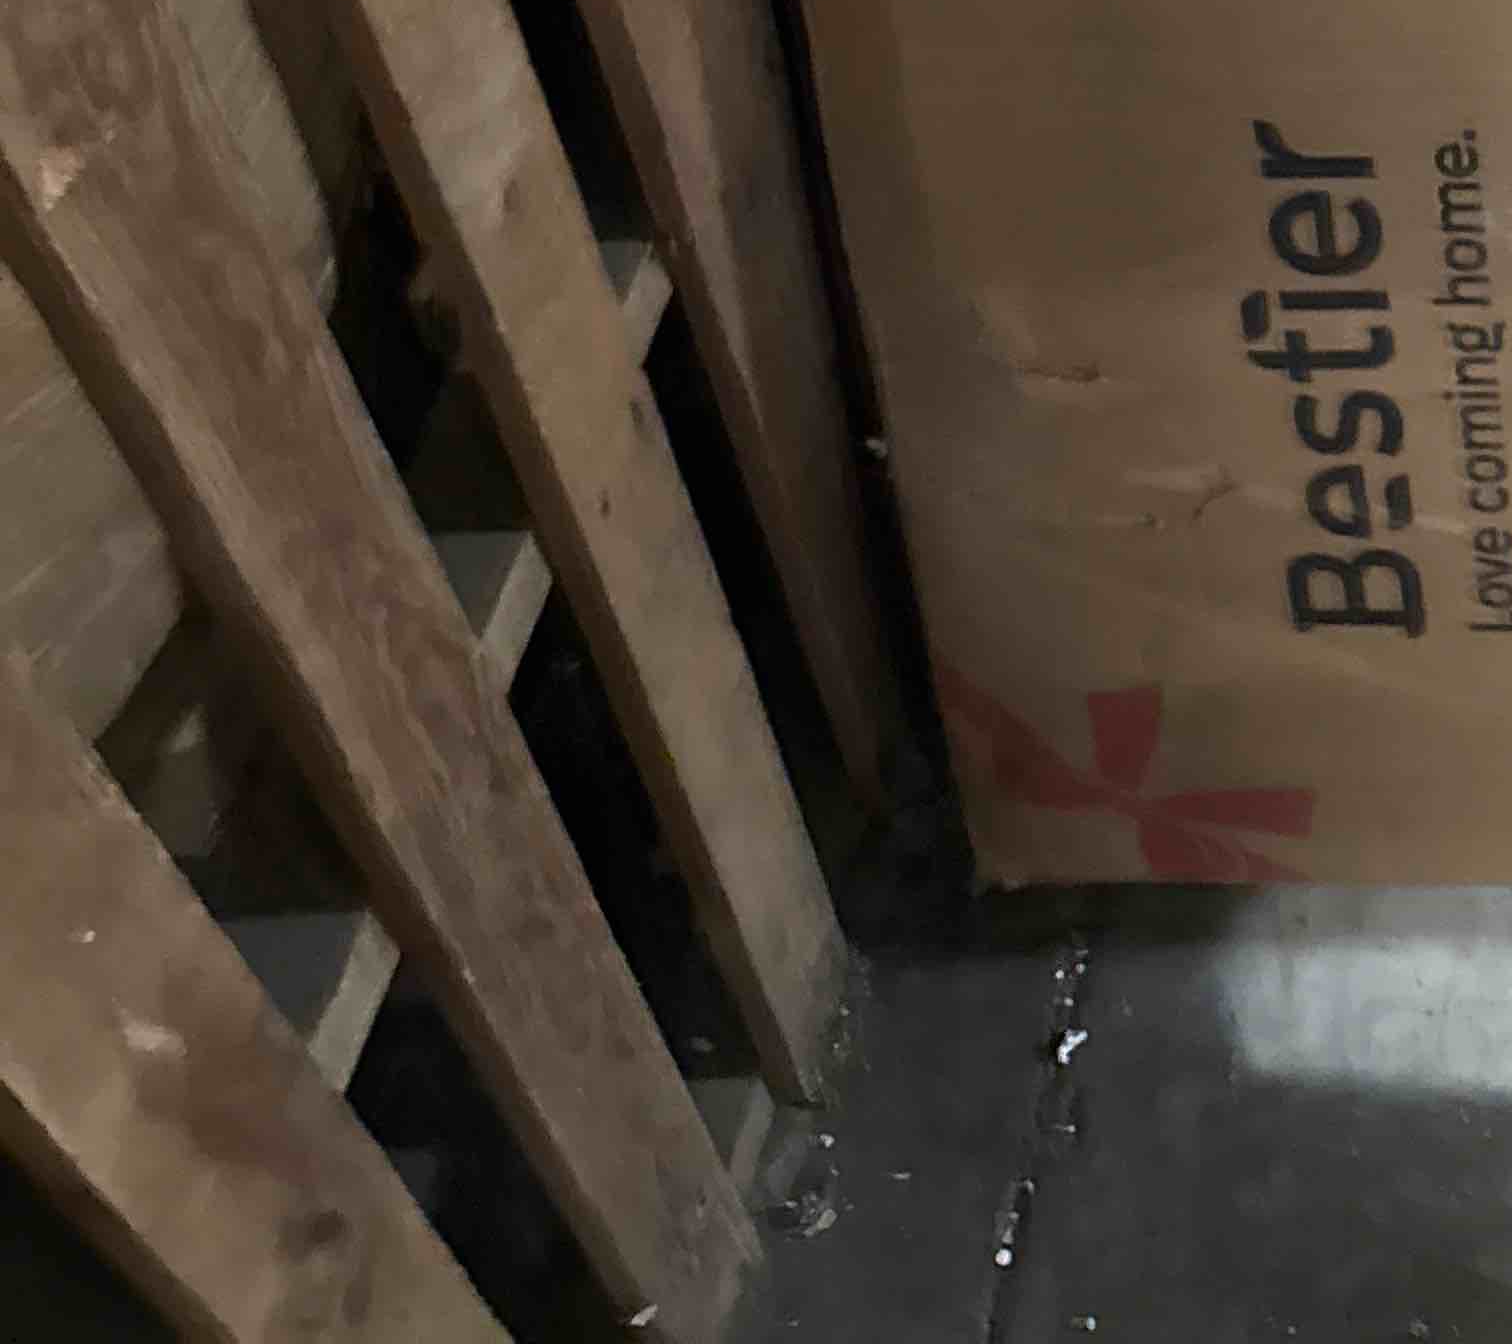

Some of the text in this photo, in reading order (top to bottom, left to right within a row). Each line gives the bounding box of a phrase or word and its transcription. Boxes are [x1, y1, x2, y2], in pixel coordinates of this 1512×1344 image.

[1429, 128, 1496, 306] home.
[1240, 120, 1424, 639] Bestier
[1443, 323, 1508, 514] coming
